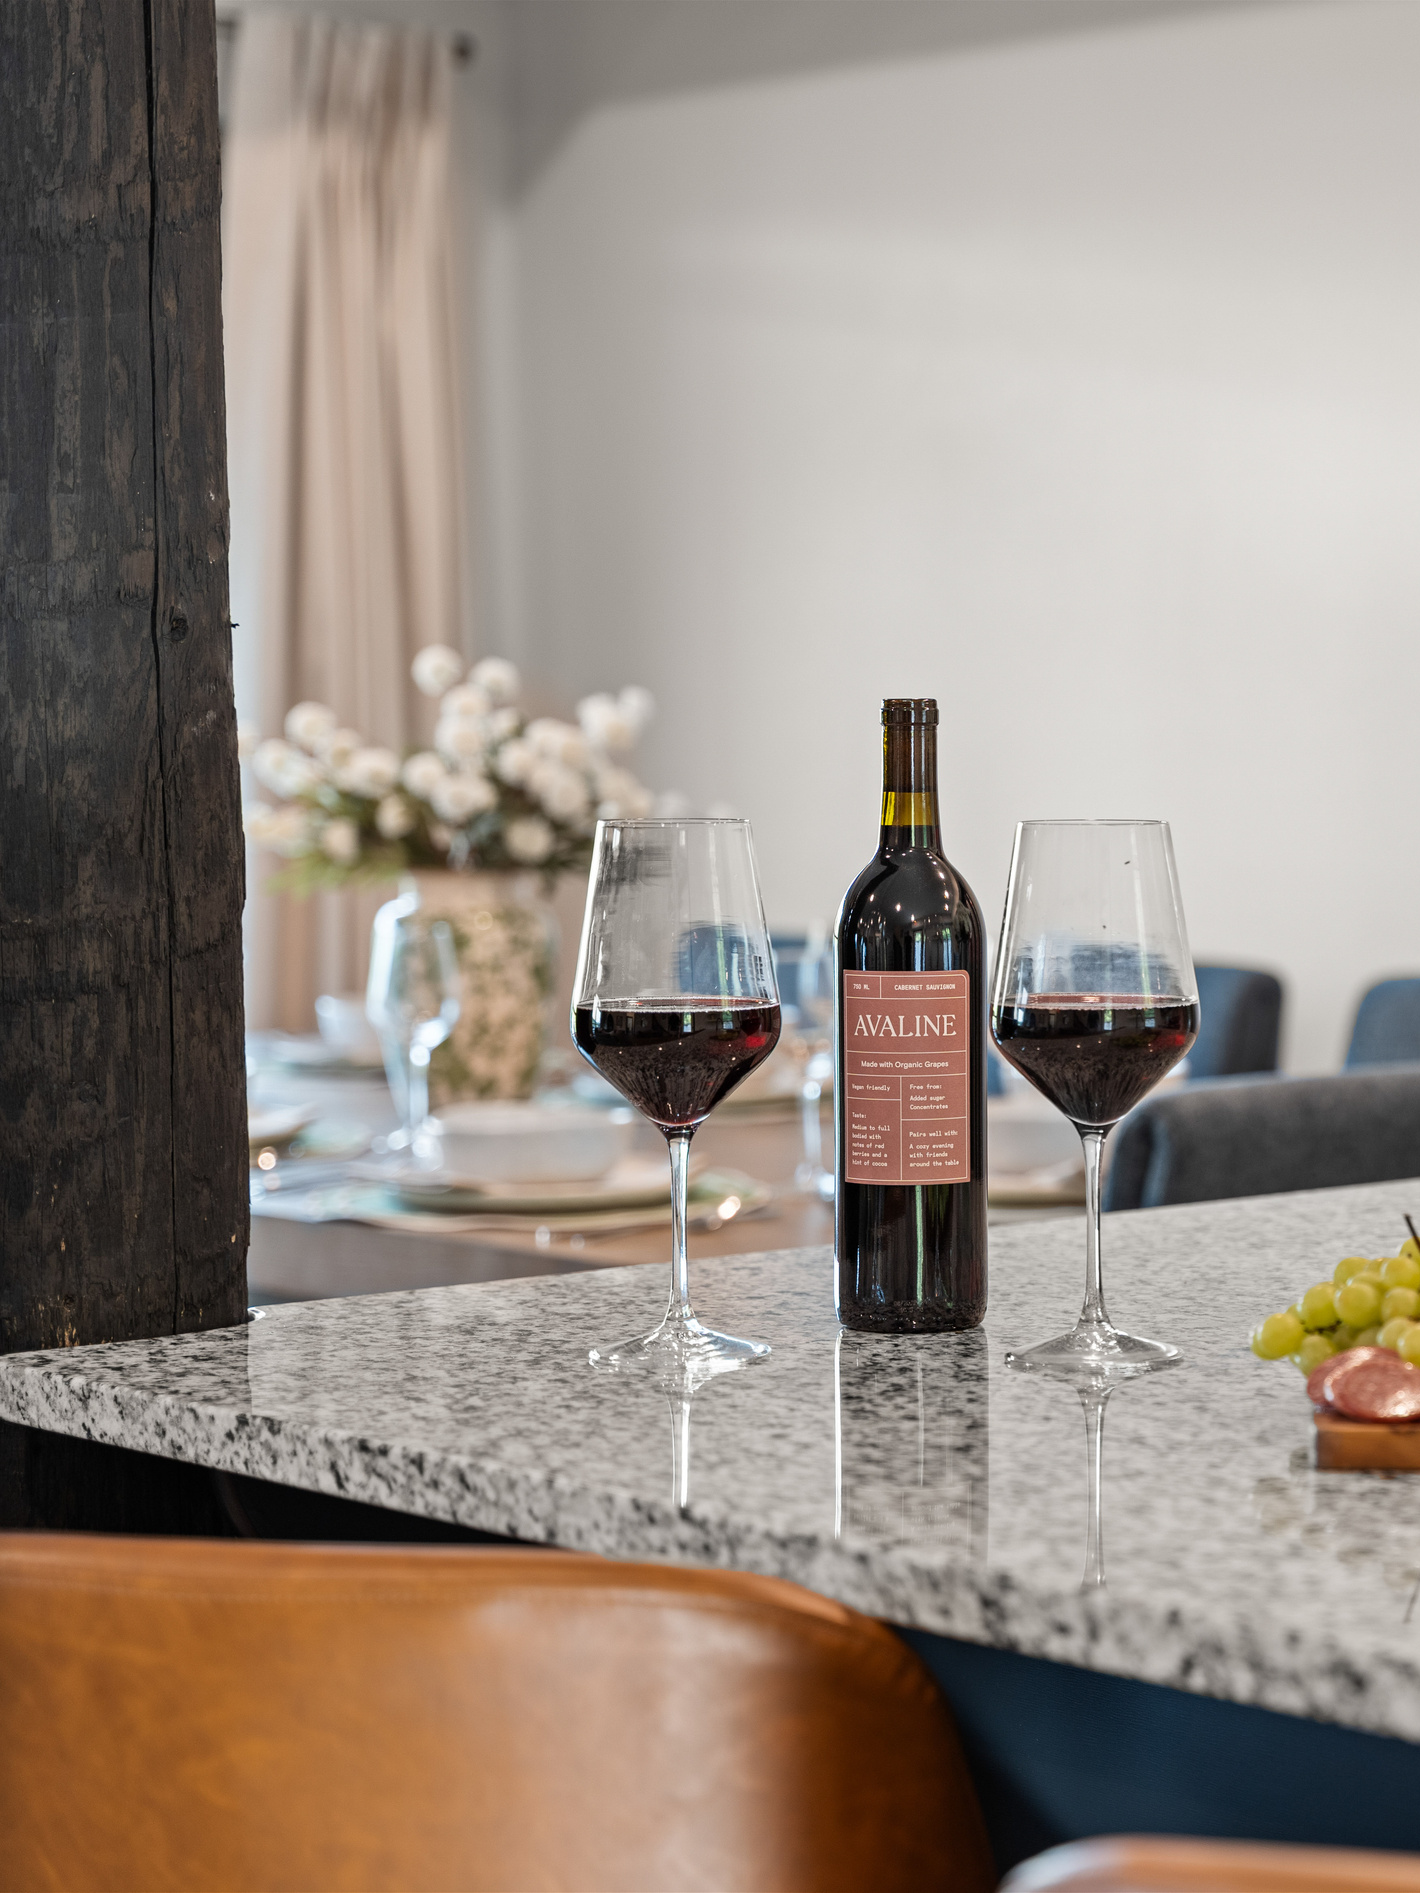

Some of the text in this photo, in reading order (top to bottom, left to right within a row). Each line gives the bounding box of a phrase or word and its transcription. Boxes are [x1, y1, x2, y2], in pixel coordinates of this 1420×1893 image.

[854, 1014, 957, 1037] AVALINE
[895, 1061, 922, 1069] Organic
[866, 1084, 890, 1092] friendly
